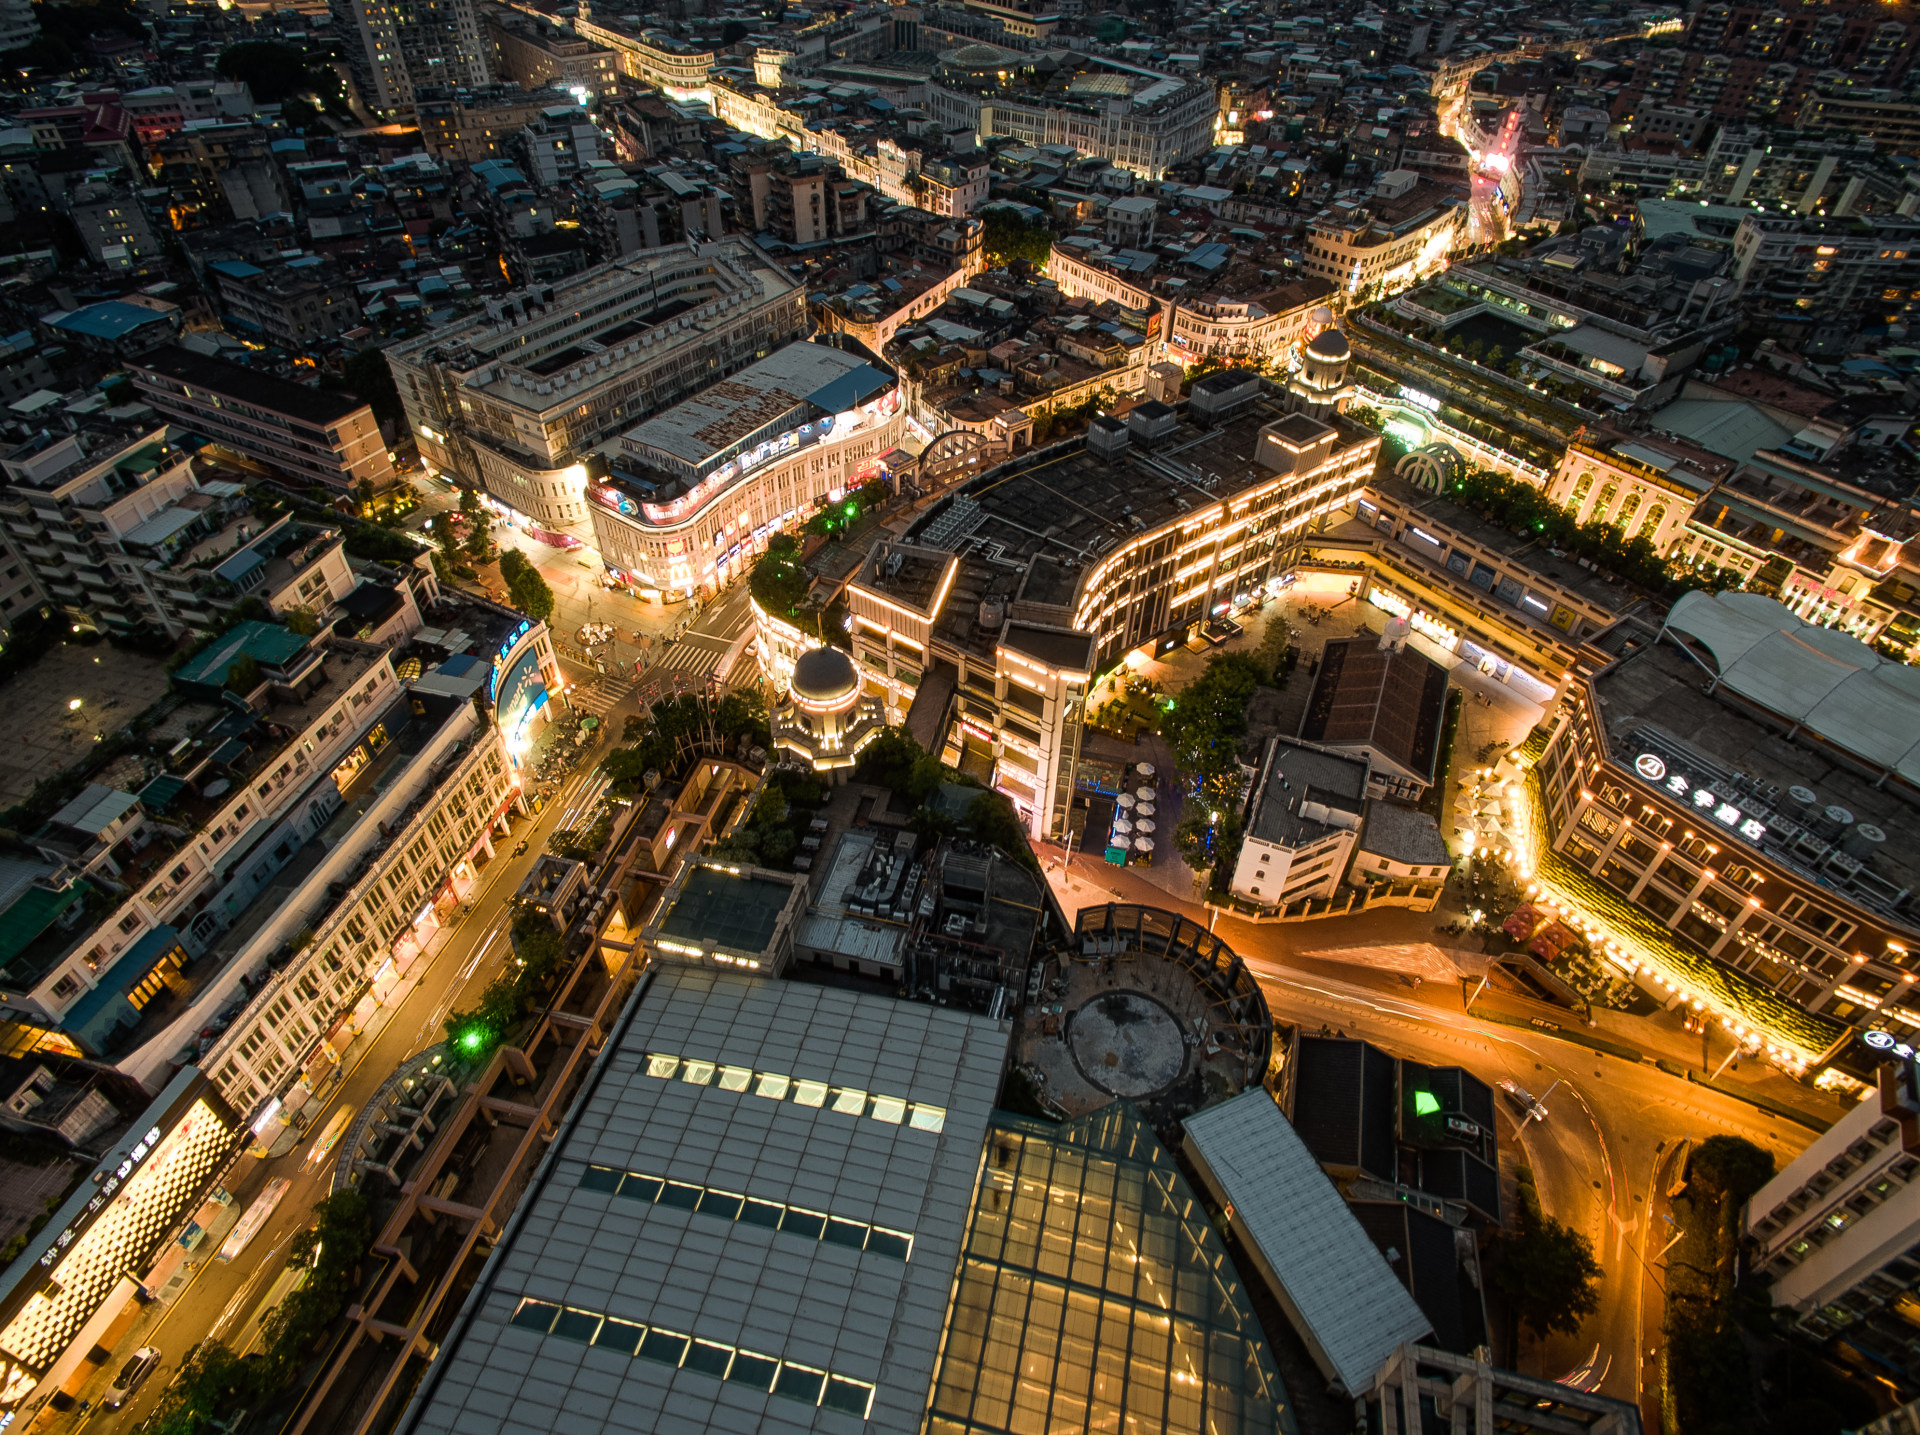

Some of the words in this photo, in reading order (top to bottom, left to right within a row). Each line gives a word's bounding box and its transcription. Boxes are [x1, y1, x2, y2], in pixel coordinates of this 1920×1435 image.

[1666, 775, 1766, 840] 全季酒店
[40, 1126, 161, 1266] 钟爱一生婚纱摄影
